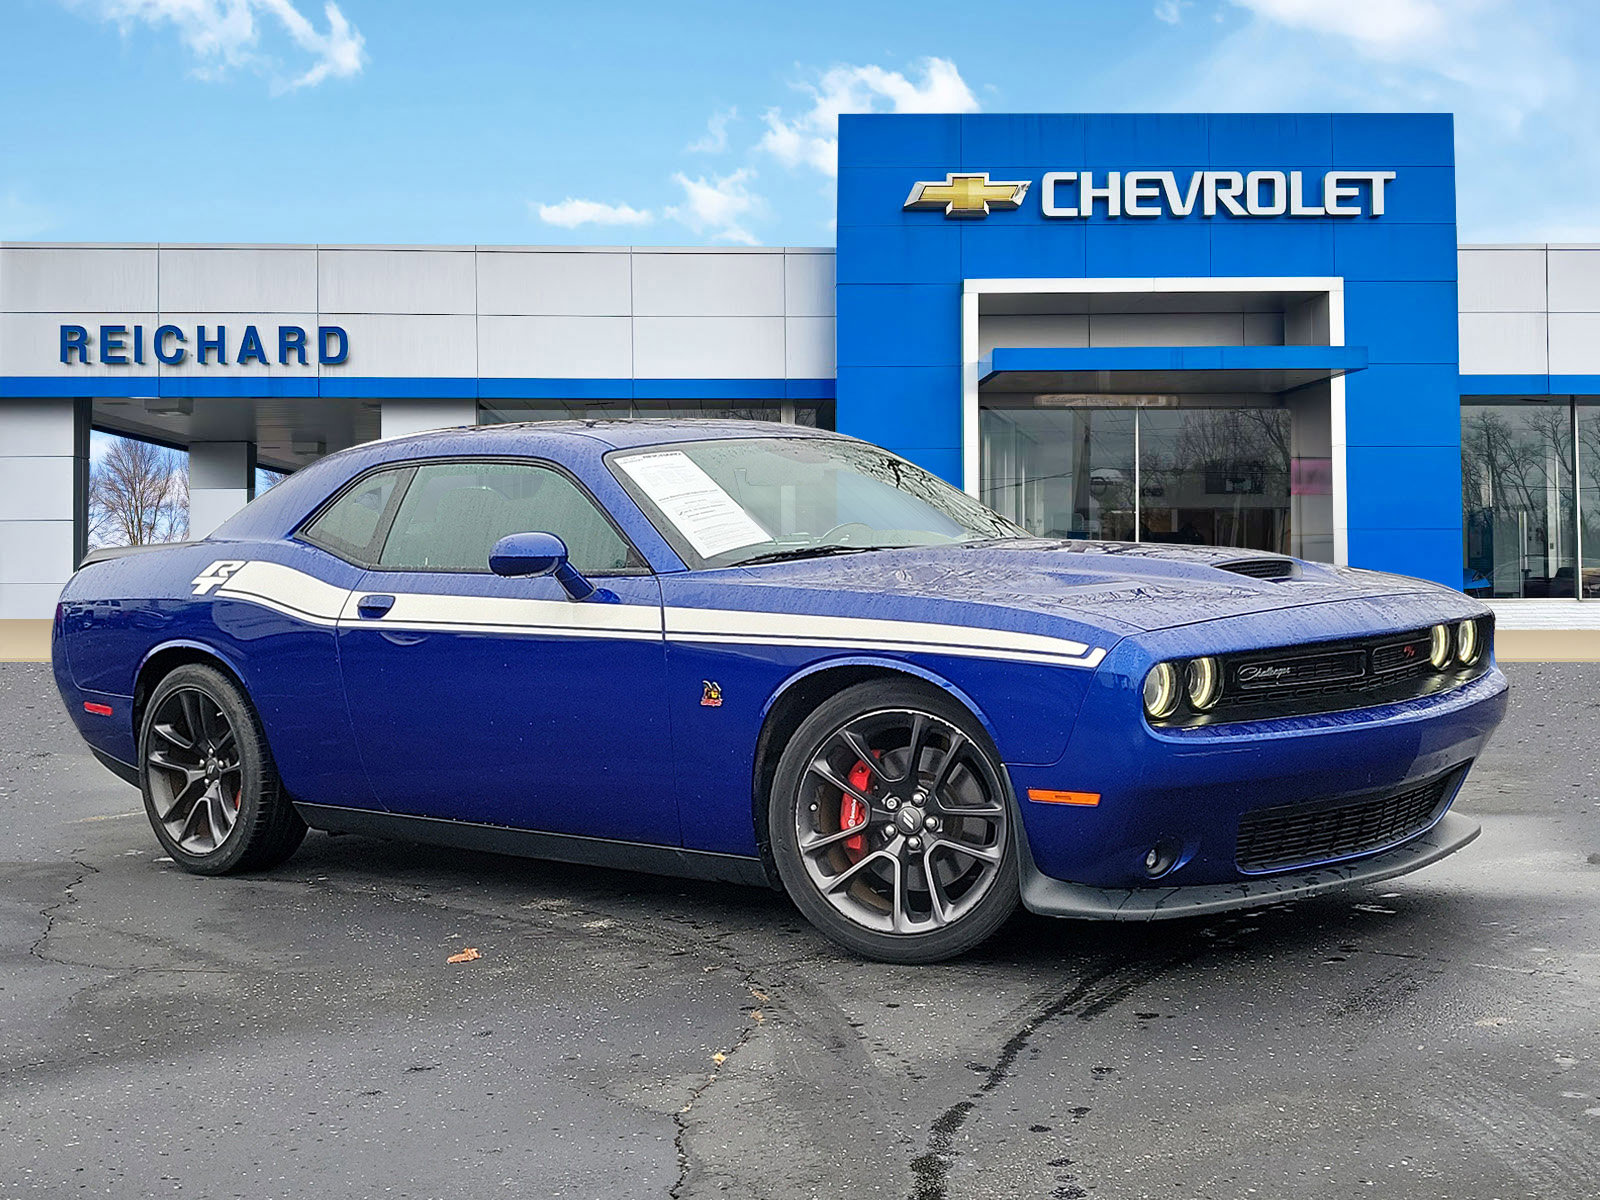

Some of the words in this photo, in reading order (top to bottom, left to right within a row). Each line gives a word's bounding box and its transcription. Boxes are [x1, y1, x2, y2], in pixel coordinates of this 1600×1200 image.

[1042, 171, 1396, 217] CHEVROLET
[59, 325, 349, 365] REICHARD
[1239, 666, 1291, 681] Challenger
